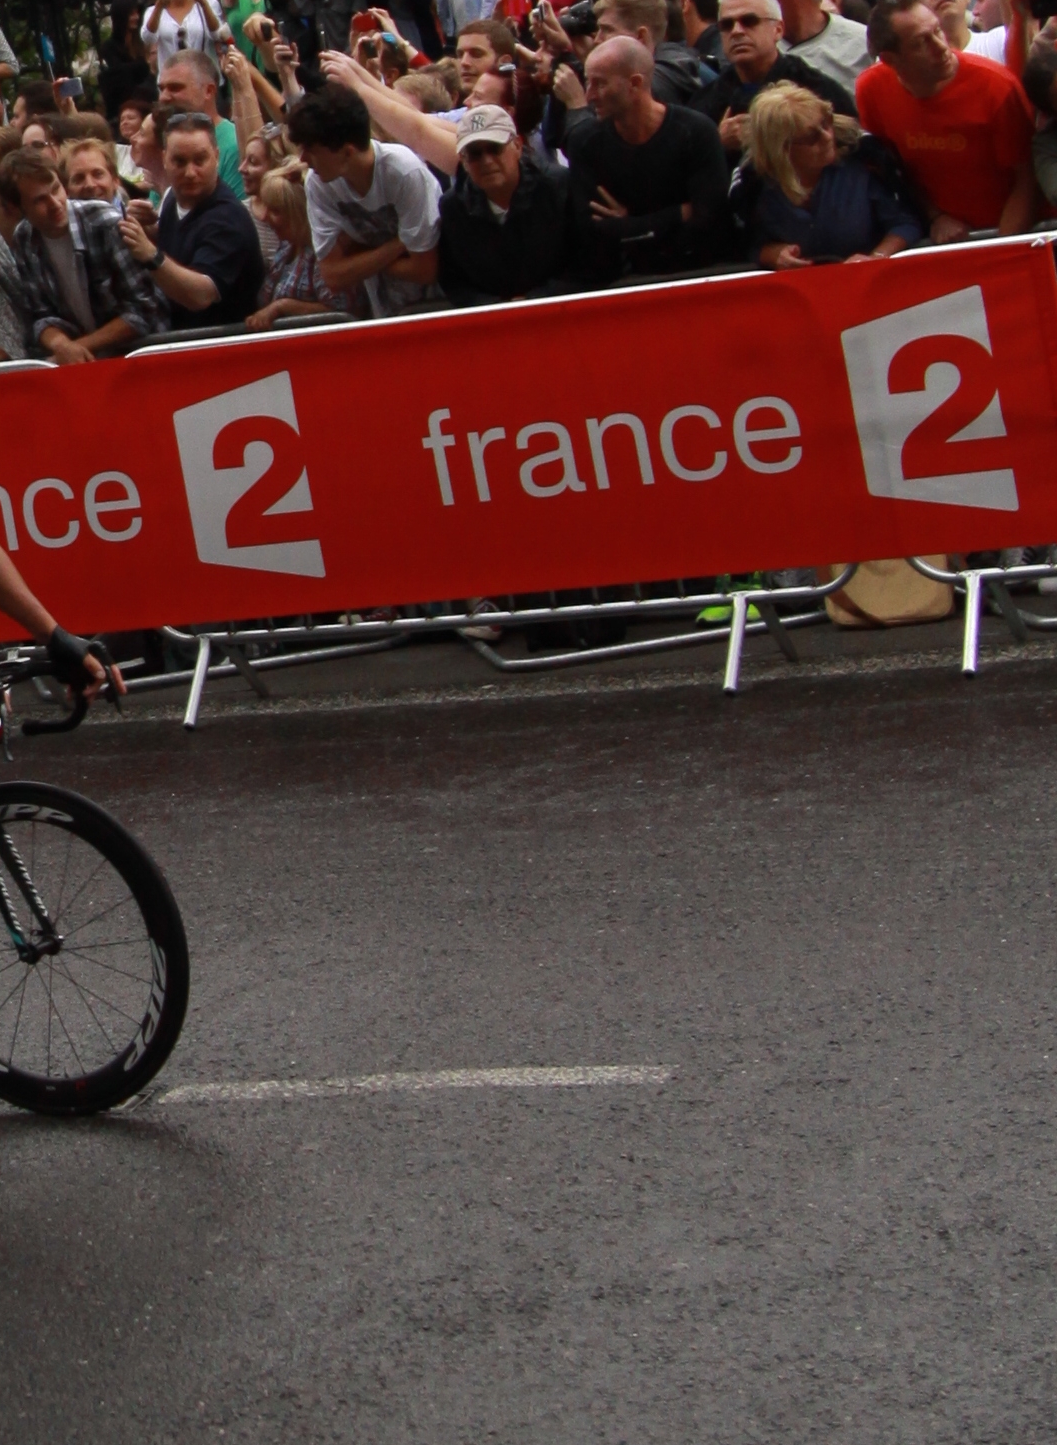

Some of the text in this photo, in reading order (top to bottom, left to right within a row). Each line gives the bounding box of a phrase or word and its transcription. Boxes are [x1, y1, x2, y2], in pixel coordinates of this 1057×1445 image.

[211, 413, 308, 551] 2
[422, 332, 1007, 506] france 2
